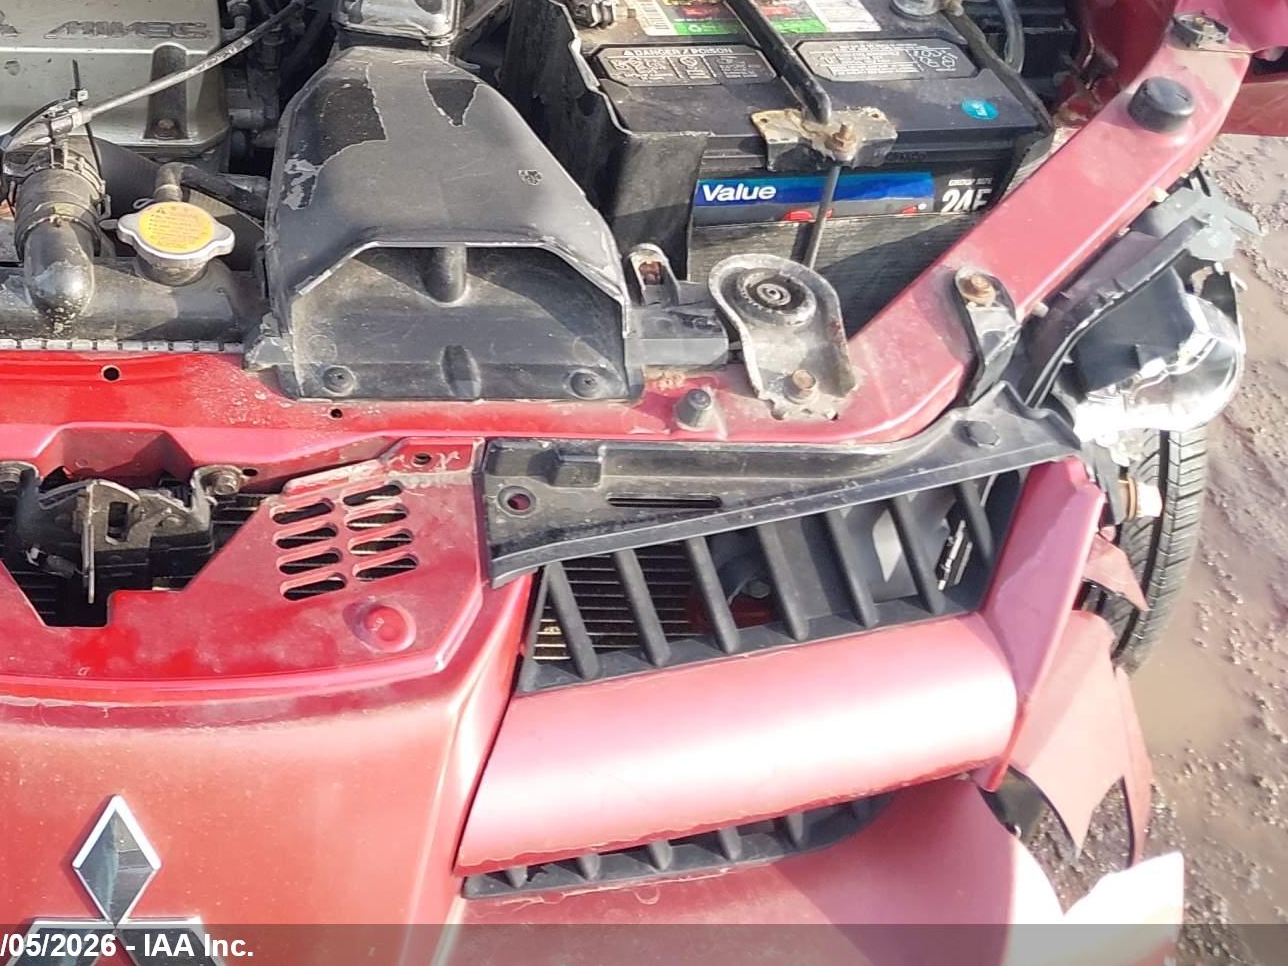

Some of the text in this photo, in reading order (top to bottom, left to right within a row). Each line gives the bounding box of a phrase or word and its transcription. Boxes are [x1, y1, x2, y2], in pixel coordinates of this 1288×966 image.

[634, 48, 681, 57] DANGER
[690, 47, 734, 55] POISON
[702, 183, 776, 202] Value
